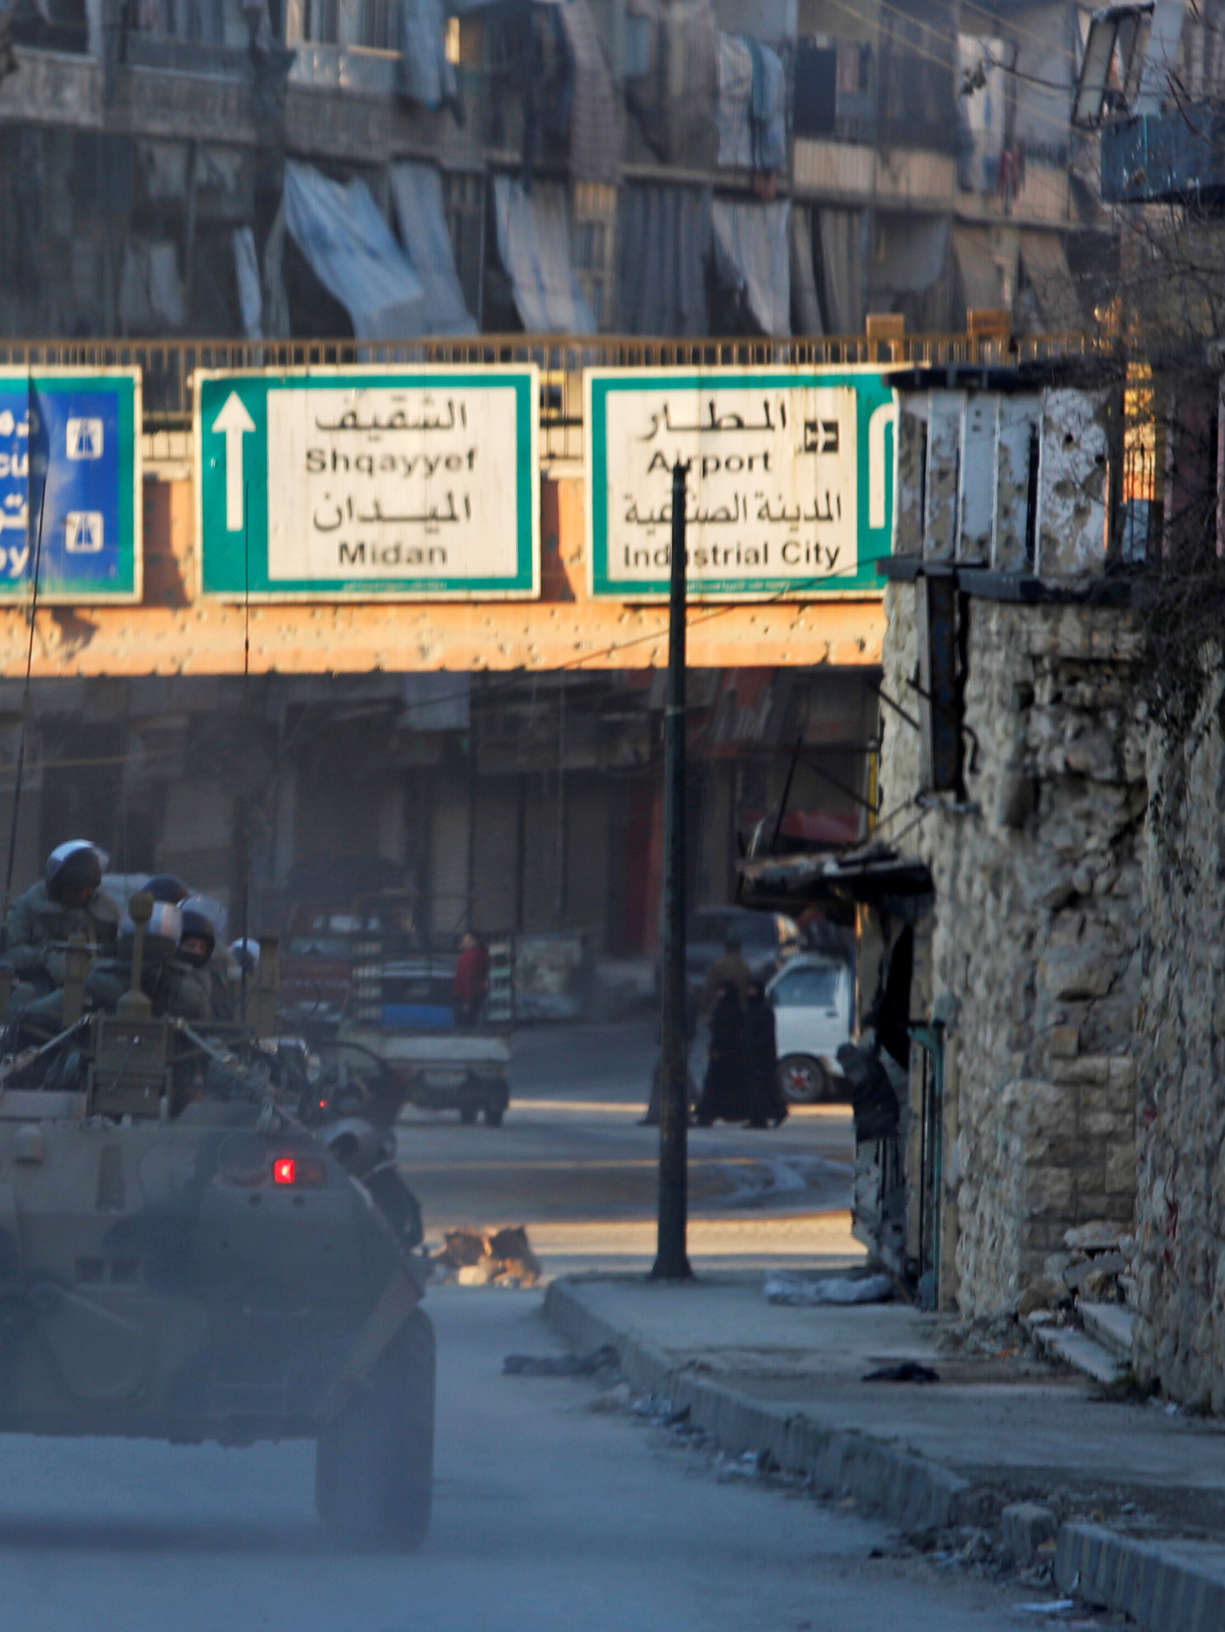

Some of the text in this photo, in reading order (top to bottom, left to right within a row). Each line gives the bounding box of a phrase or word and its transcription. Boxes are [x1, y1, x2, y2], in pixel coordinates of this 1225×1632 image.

[639, 399, 788, 442] المطار
[306, 447, 479, 479] Shqayyef
[647, 450, 773, 479] Airport
[314, 490, 472, 534] الميدان
[623, 489, 842, 536] المدينة الصنعية
[339, 543, 448, 566] Midan
[624, 541, 841, 569] Indstrial City
